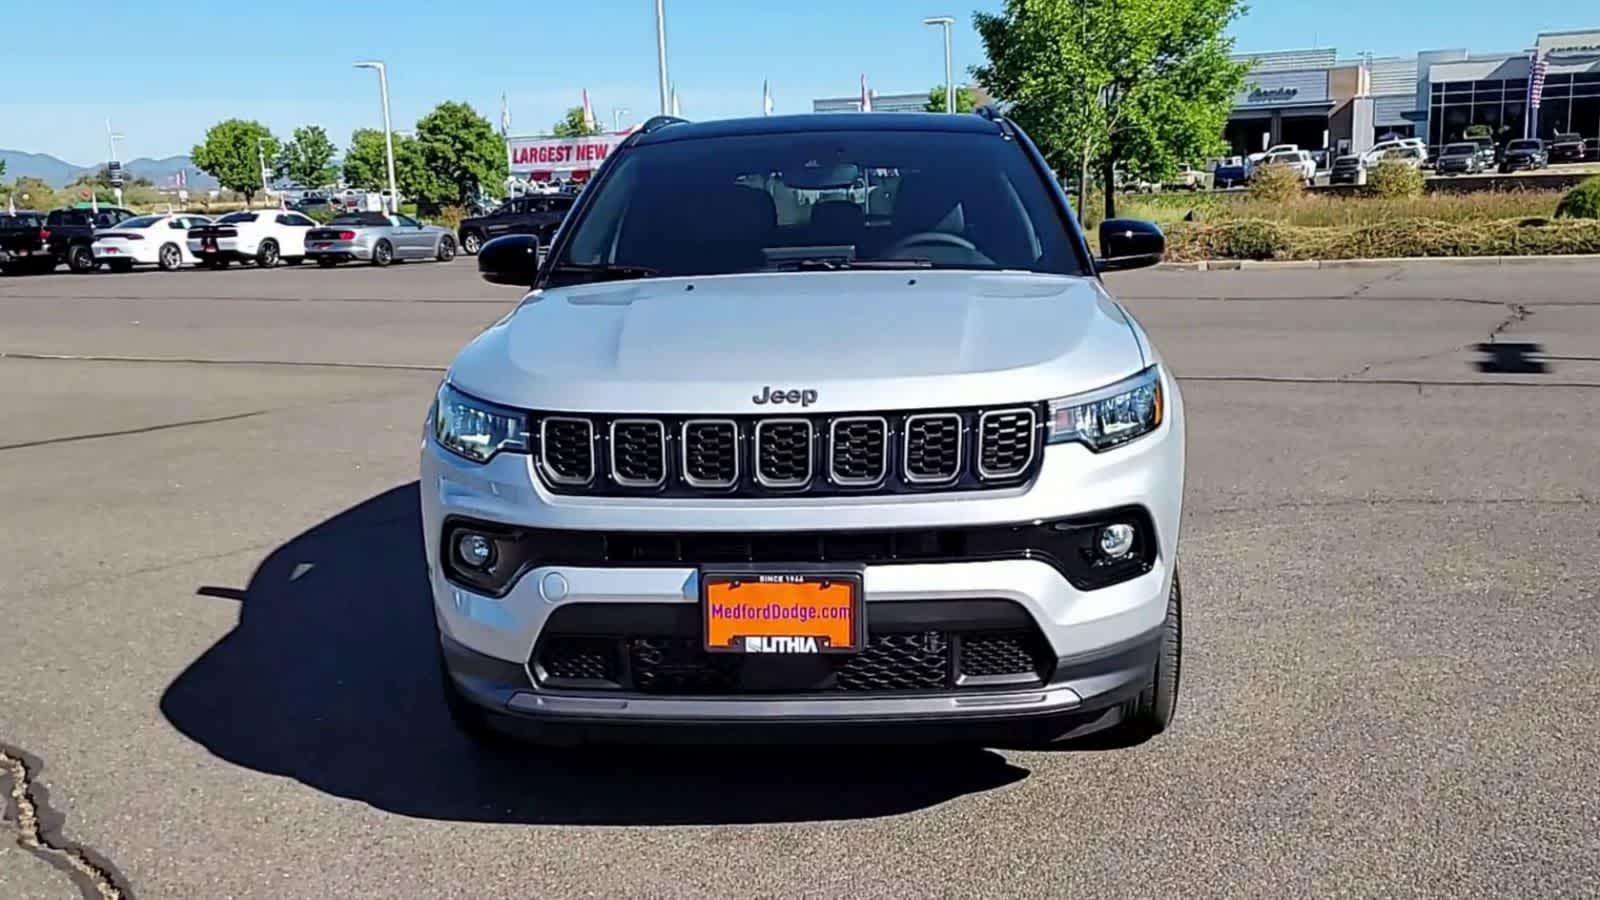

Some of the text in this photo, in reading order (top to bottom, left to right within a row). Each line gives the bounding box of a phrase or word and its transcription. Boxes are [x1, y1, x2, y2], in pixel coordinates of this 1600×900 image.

[512, 143, 608, 164] LARGEST NEW
[752, 386, 818, 407] Jeep
[759, 575, 783, 583] SINCE
[712, 604, 850, 621] MedfordDodge.com
[762, 636, 818, 653] LITHIA
